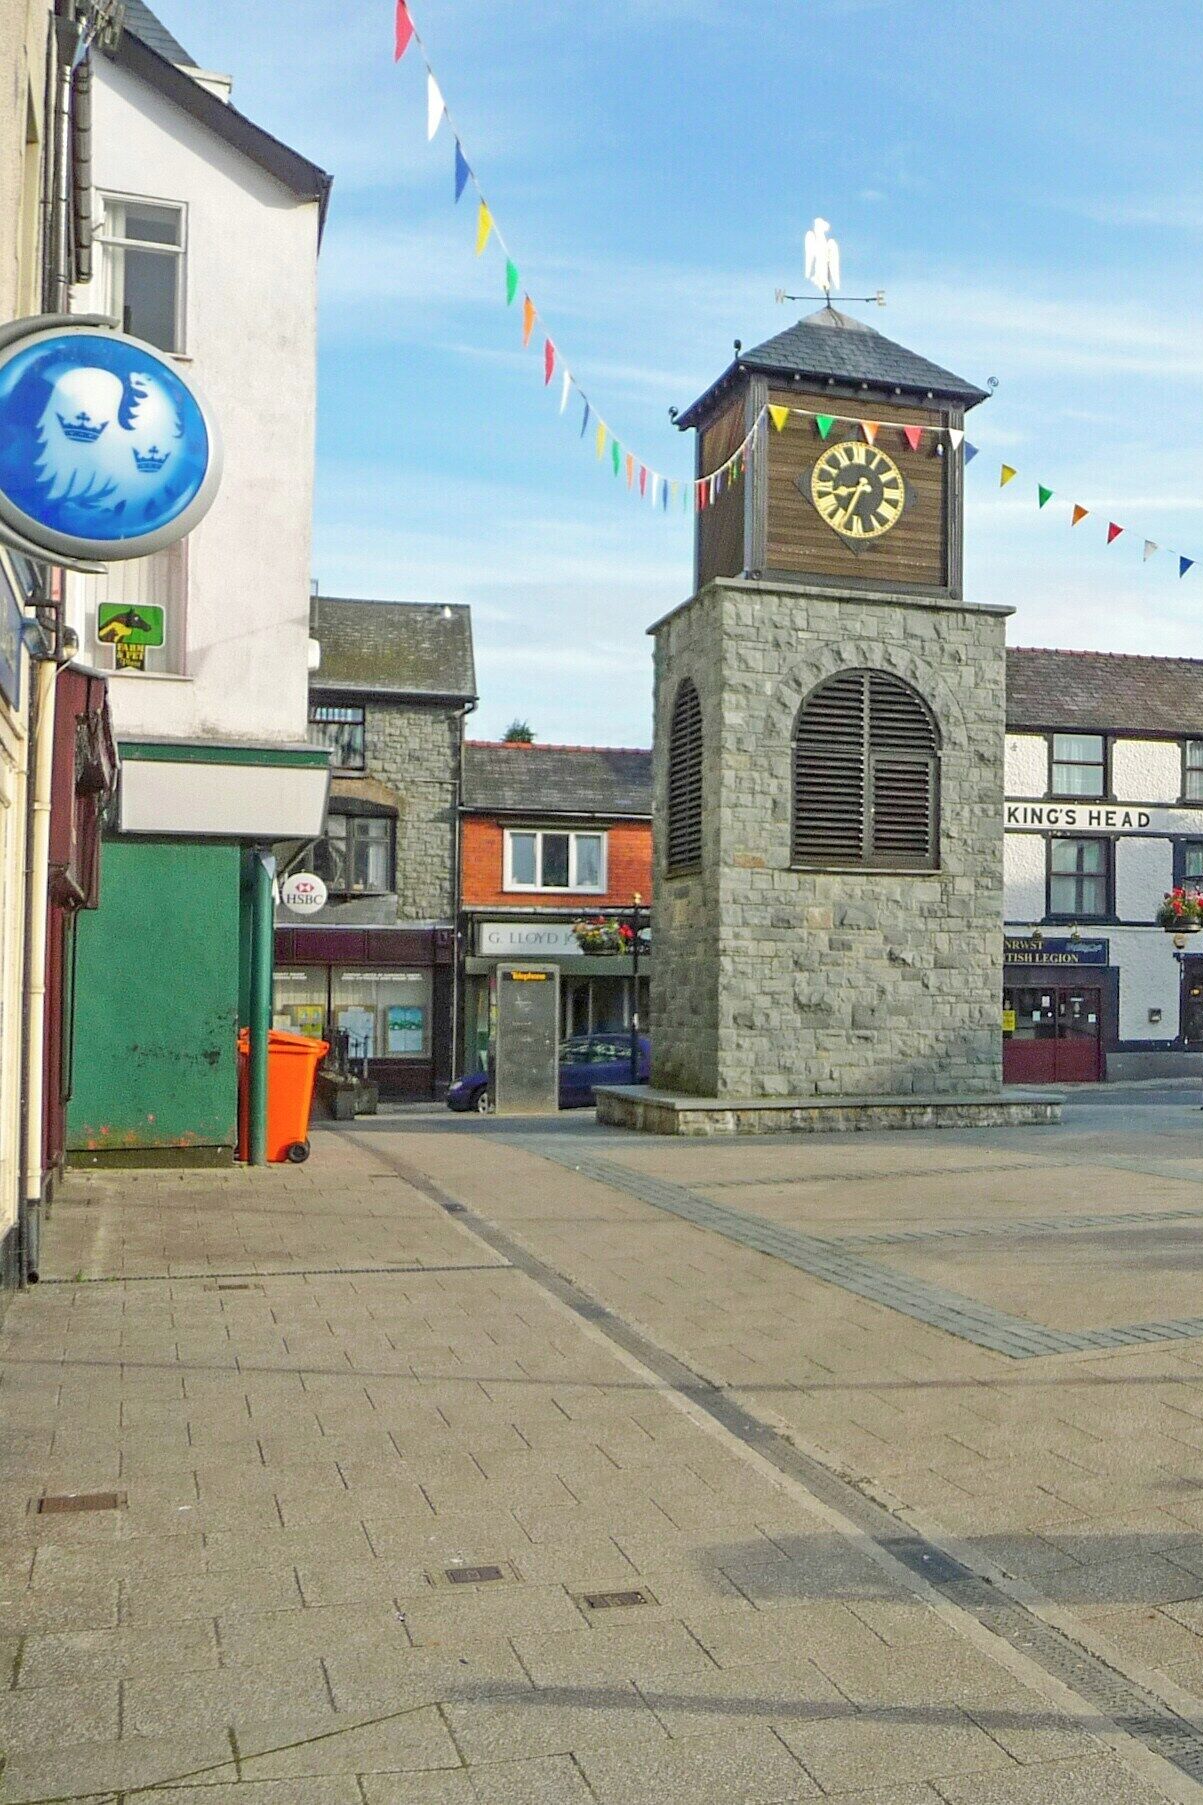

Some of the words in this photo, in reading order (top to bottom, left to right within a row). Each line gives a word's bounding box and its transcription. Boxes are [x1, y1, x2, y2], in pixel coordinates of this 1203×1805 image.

[1007, 807, 1076, 825] KING'S
[1089, 810, 1150, 828] HEAD
[286, 894, 323, 905] HSBC
[509, 932, 558, 945] LLOYD
[1035, 953, 1079, 963] LEGION
